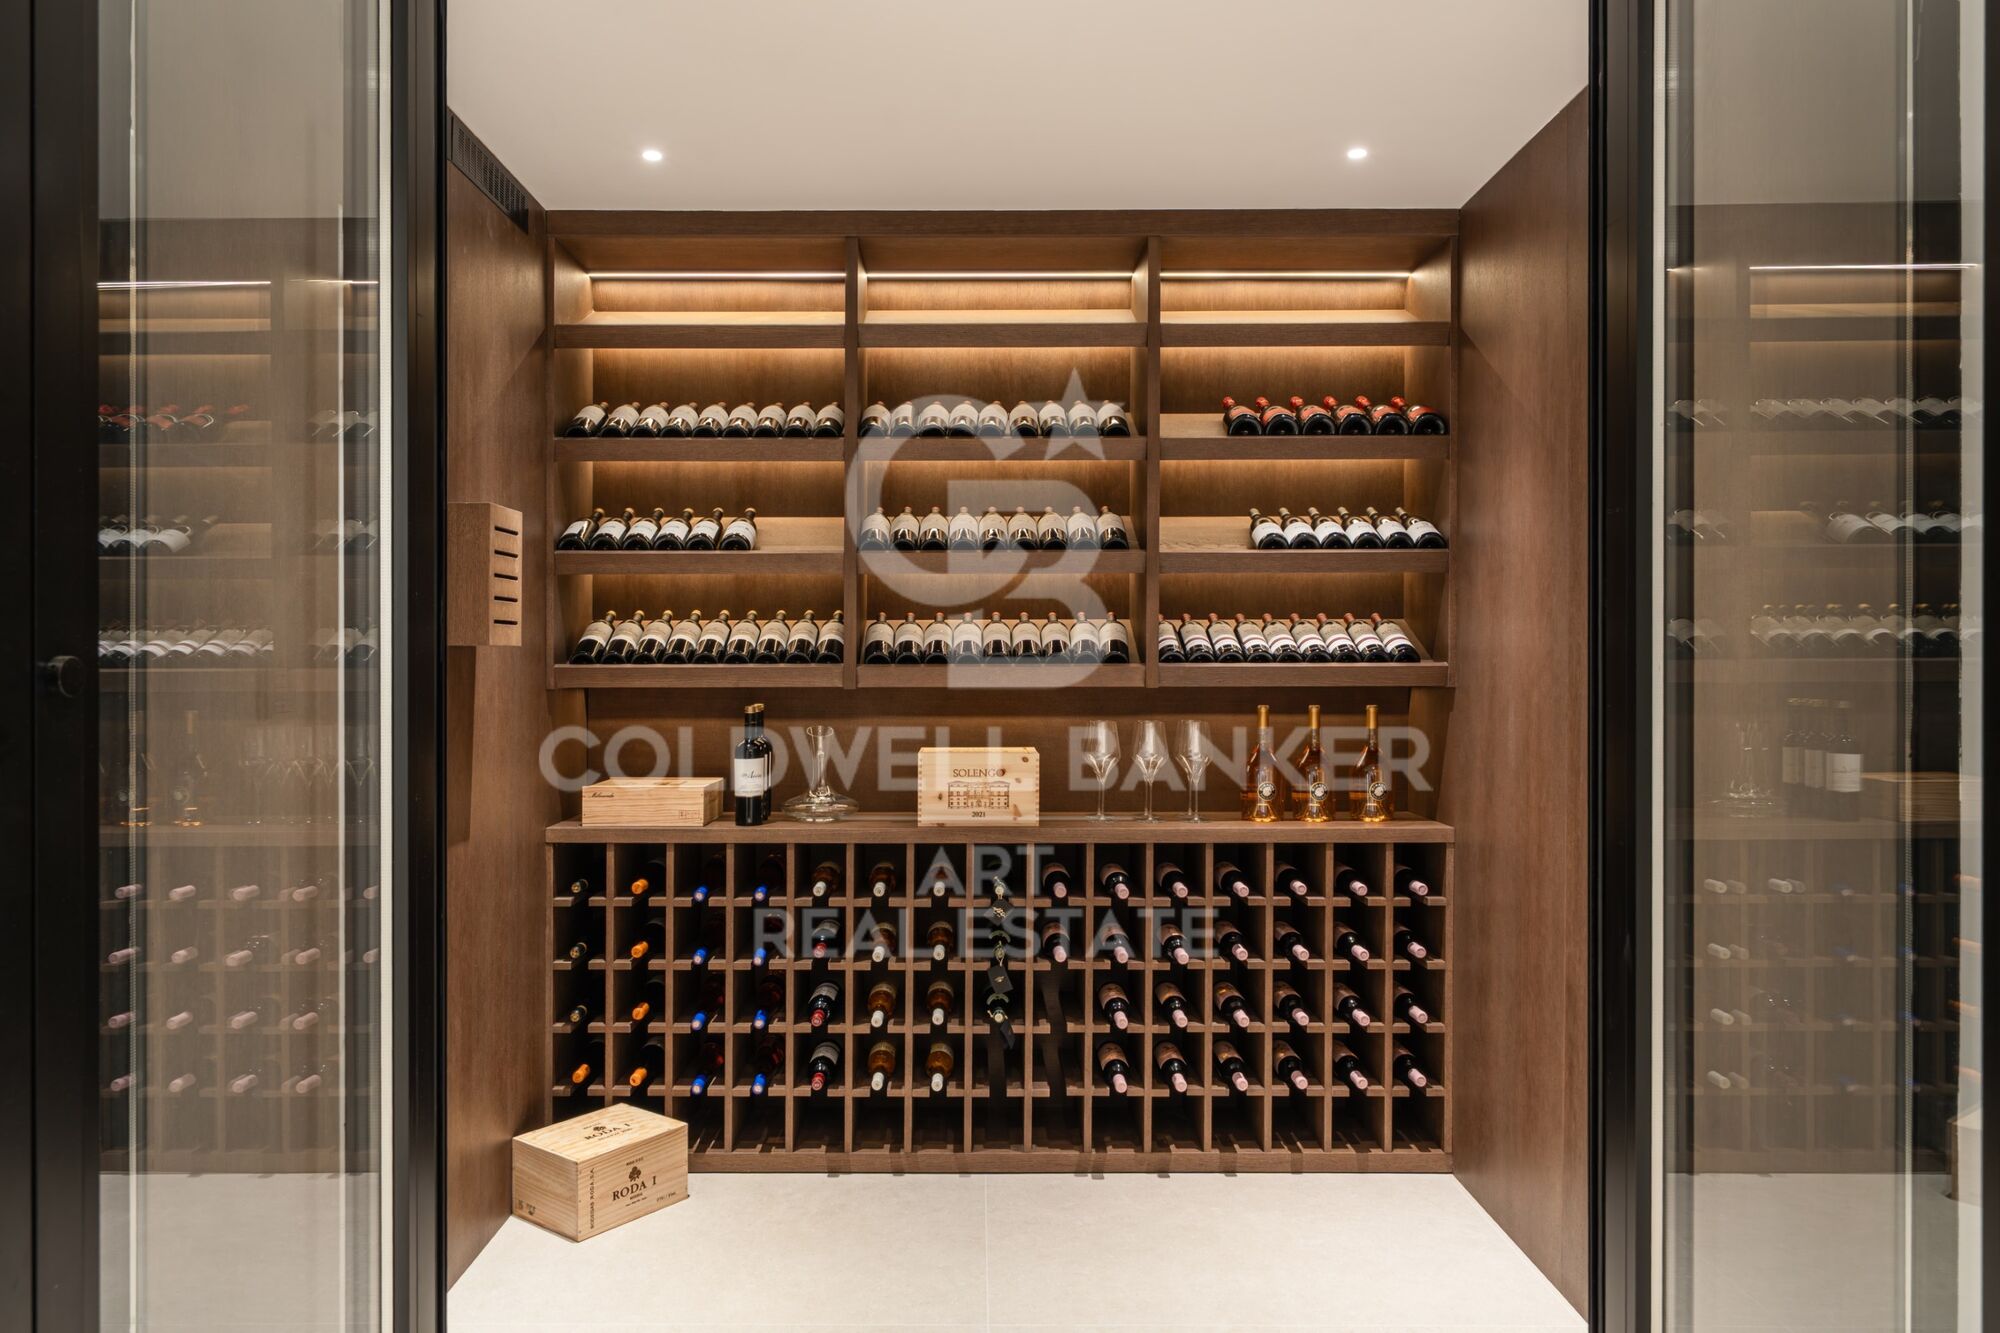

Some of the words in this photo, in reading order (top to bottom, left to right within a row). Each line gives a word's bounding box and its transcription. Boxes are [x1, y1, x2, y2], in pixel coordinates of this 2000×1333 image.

[953, 768, 1006, 778] SOLENGO
[612, 1180, 647, 1201] RODA
[652, 1175, 657, 1186] I
